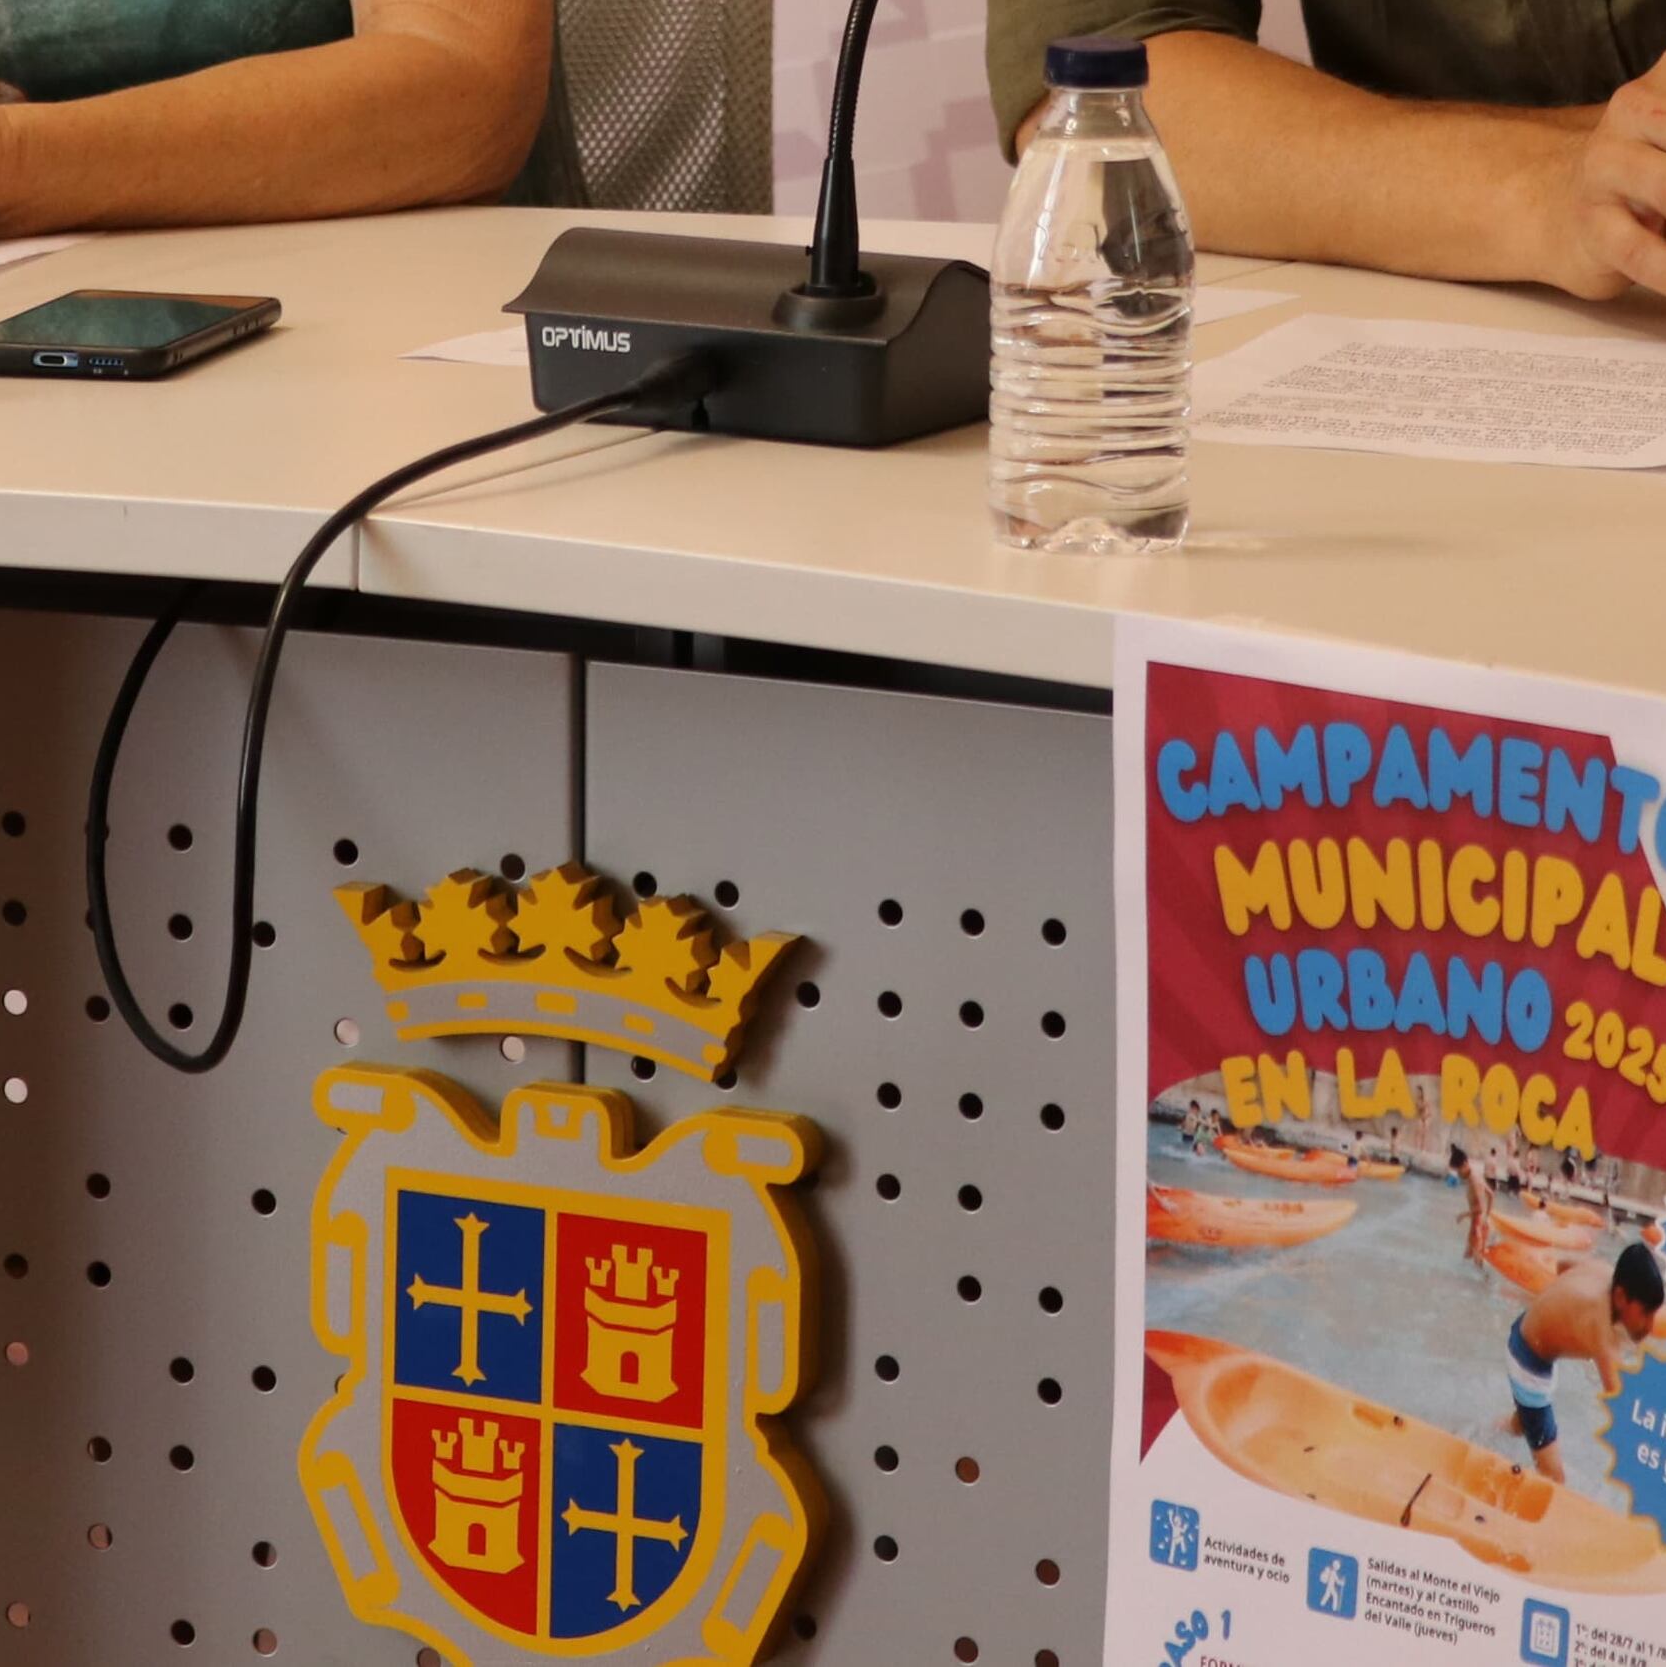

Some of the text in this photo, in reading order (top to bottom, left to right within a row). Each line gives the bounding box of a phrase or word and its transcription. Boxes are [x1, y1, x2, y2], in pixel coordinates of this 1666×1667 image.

[1244, 948, 1553, 1051] URBANO
[1220, 1047, 1595, 1160] EN LA ROCA
[1631, 1399, 1656, 1431] La
[1637, 1442, 1659, 1470] es
[1203, 1554, 1290, 1583] aventura y ocio
[1204, 1536, 1285, 1567] Actividades de
[1366, 1575, 1480, 1614] (martes) y al Castillo
[1368, 1557, 1500, 1604] Salidas al Monte el Viejo
[1365, 1609, 1458, 1646] del Valle (jueves)
[1366, 1592, 1496, 1637] Encantado en Trigueros
[1158, 1609, 1231, 1667] ASO 1
[1590, 1645, 1606, 1661] del
[1591, 1628, 1607, 1642] del
